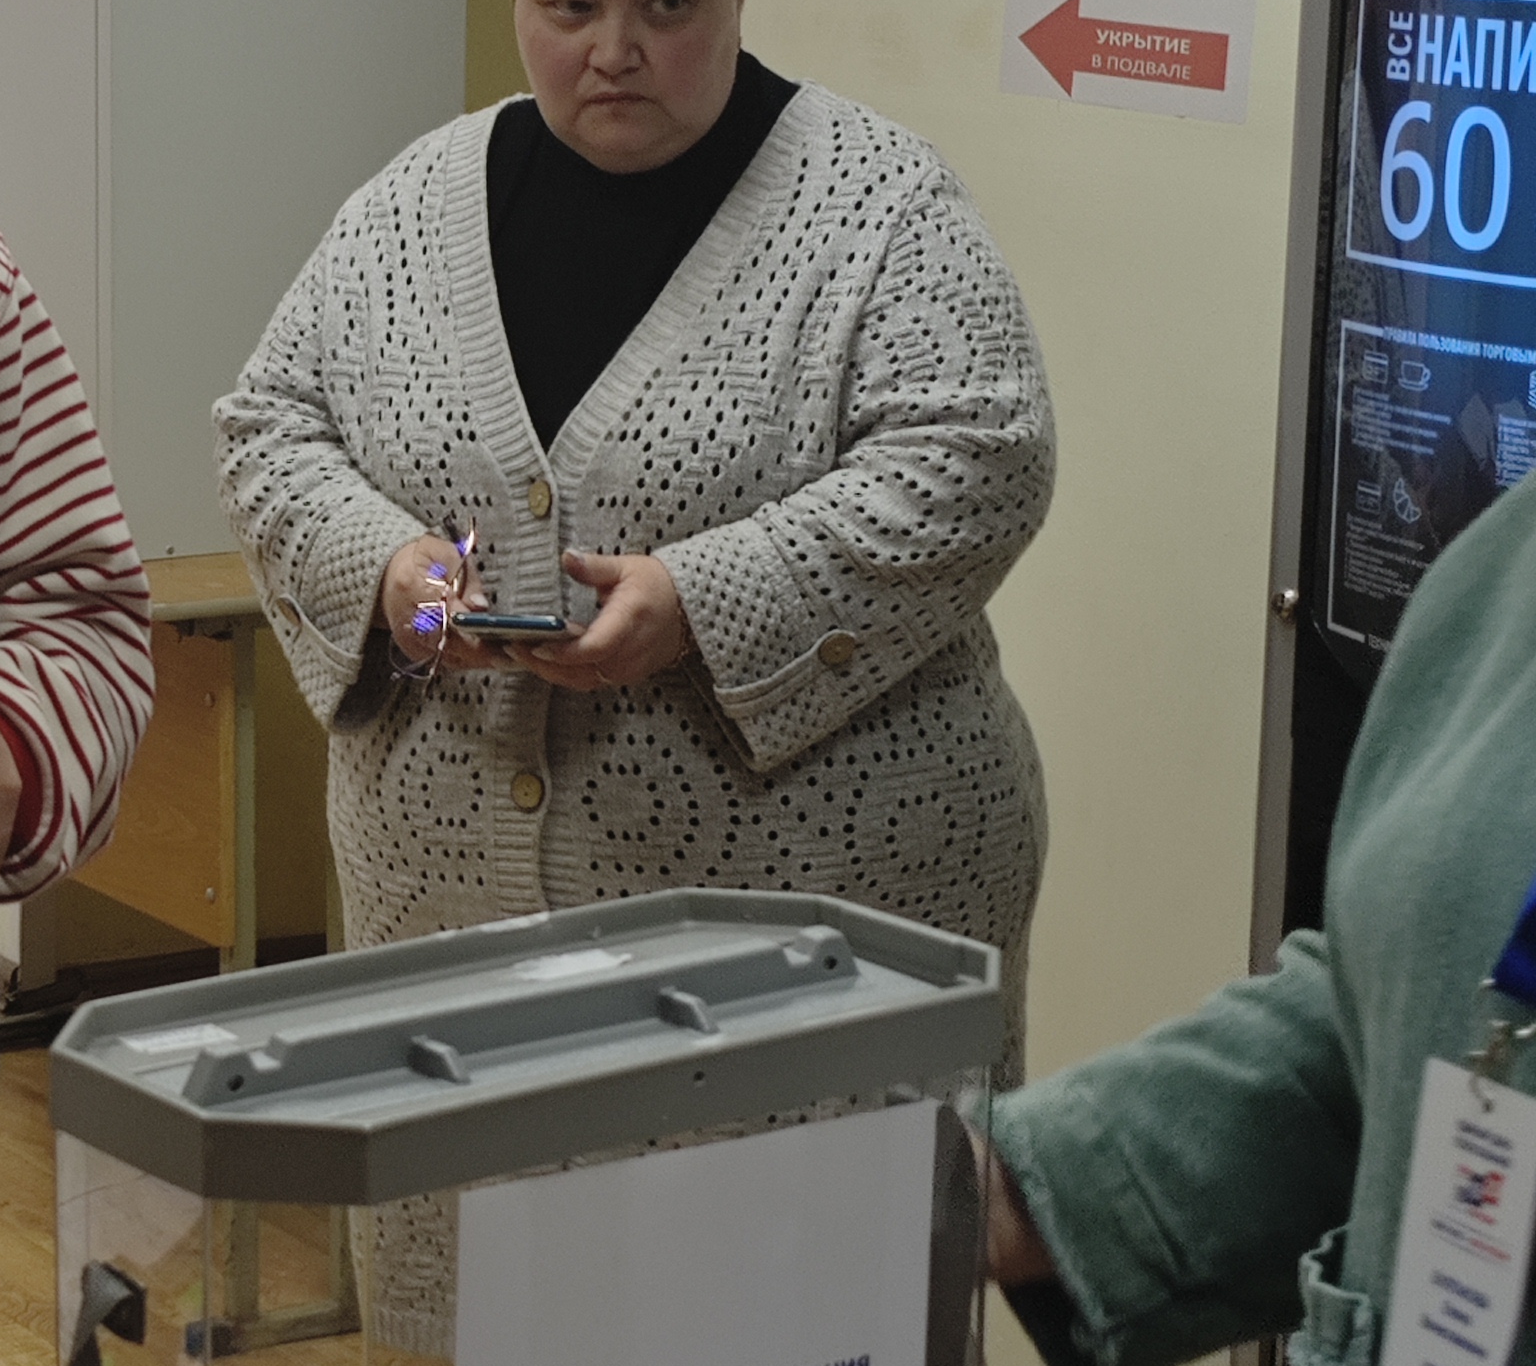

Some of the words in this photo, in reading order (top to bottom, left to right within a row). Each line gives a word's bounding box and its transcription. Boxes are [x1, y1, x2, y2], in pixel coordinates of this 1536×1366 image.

[1096, 28, 1191, 55] УКРЫТИЕ
[1386, 10, 1414, 81] ВСЕ
[1091, 54, 1102, 68] В
[1107, 56, 1192, 80] ПОДВАЛЕ
[1380, 100, 1511, 252] 60
[1418, 332, 1481, 357] ПОЛЬЗОВАНИЯ
